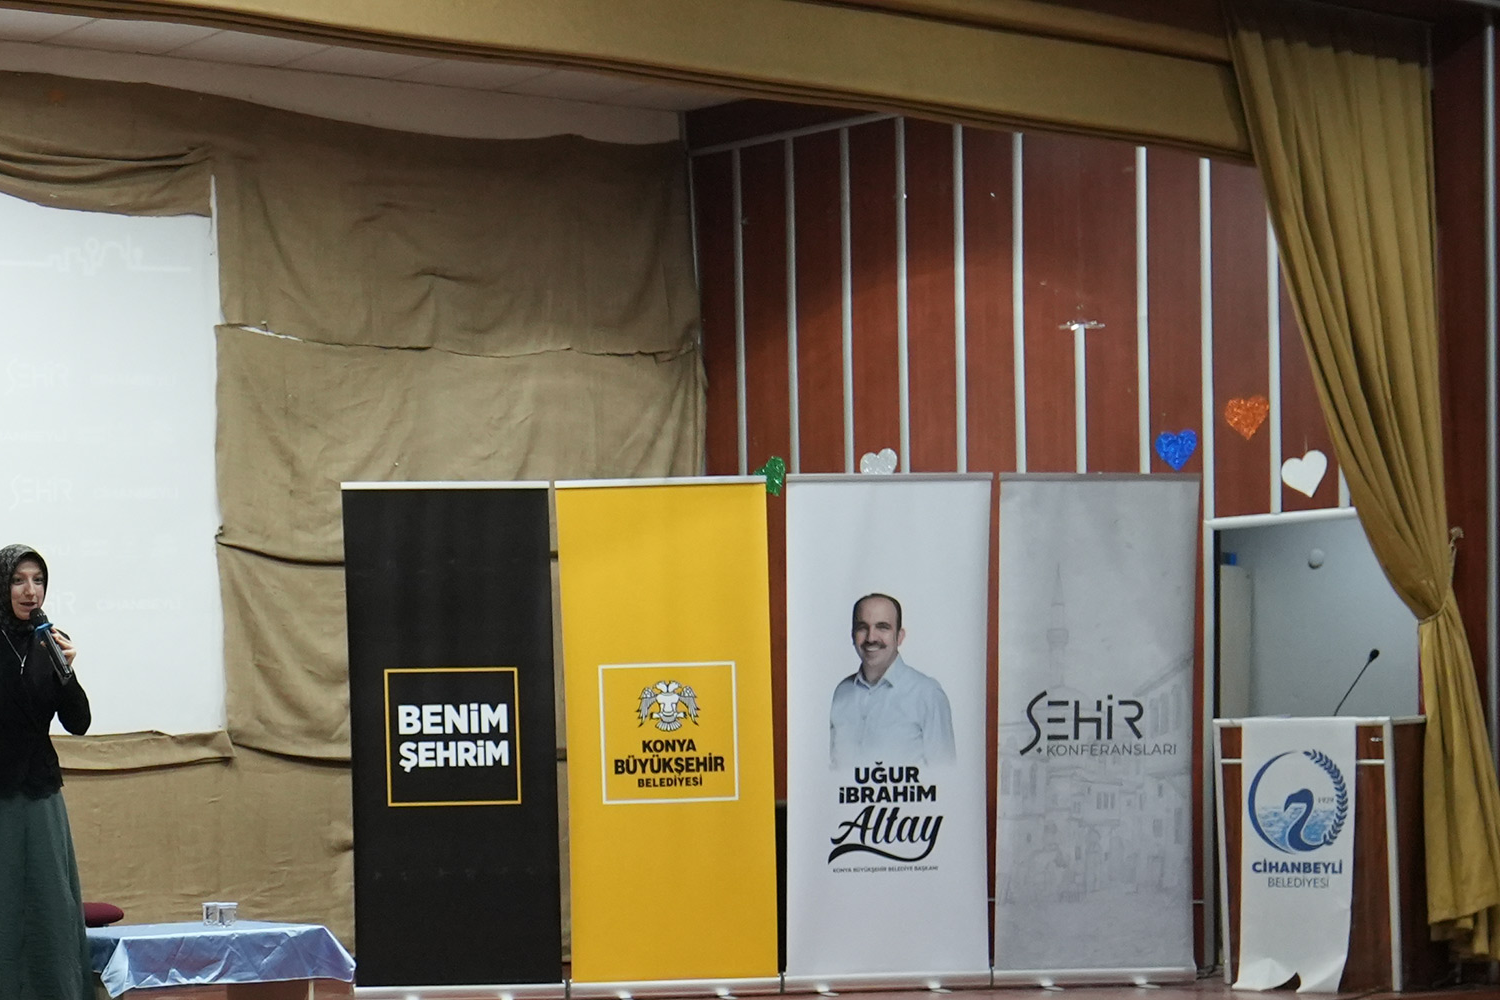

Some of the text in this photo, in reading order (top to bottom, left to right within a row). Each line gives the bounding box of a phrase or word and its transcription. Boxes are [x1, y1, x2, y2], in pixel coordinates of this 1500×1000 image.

[642, 738, 697, 753] KONYA
[1046, 743, 1177, 757] KONFERANSLARI
[614, 752, 725, 775] BÜYÜKŞEHİR
[854, 760, 920, 784] UĞUR
[637, 776, 703, 788] BELEDİYESİ
[828, 805, 944, 865] Altay
[1251, 858, 1343, 874] CİHANBEYLİ
[1267, 877, 1329, 889] BELEDİYESİ
